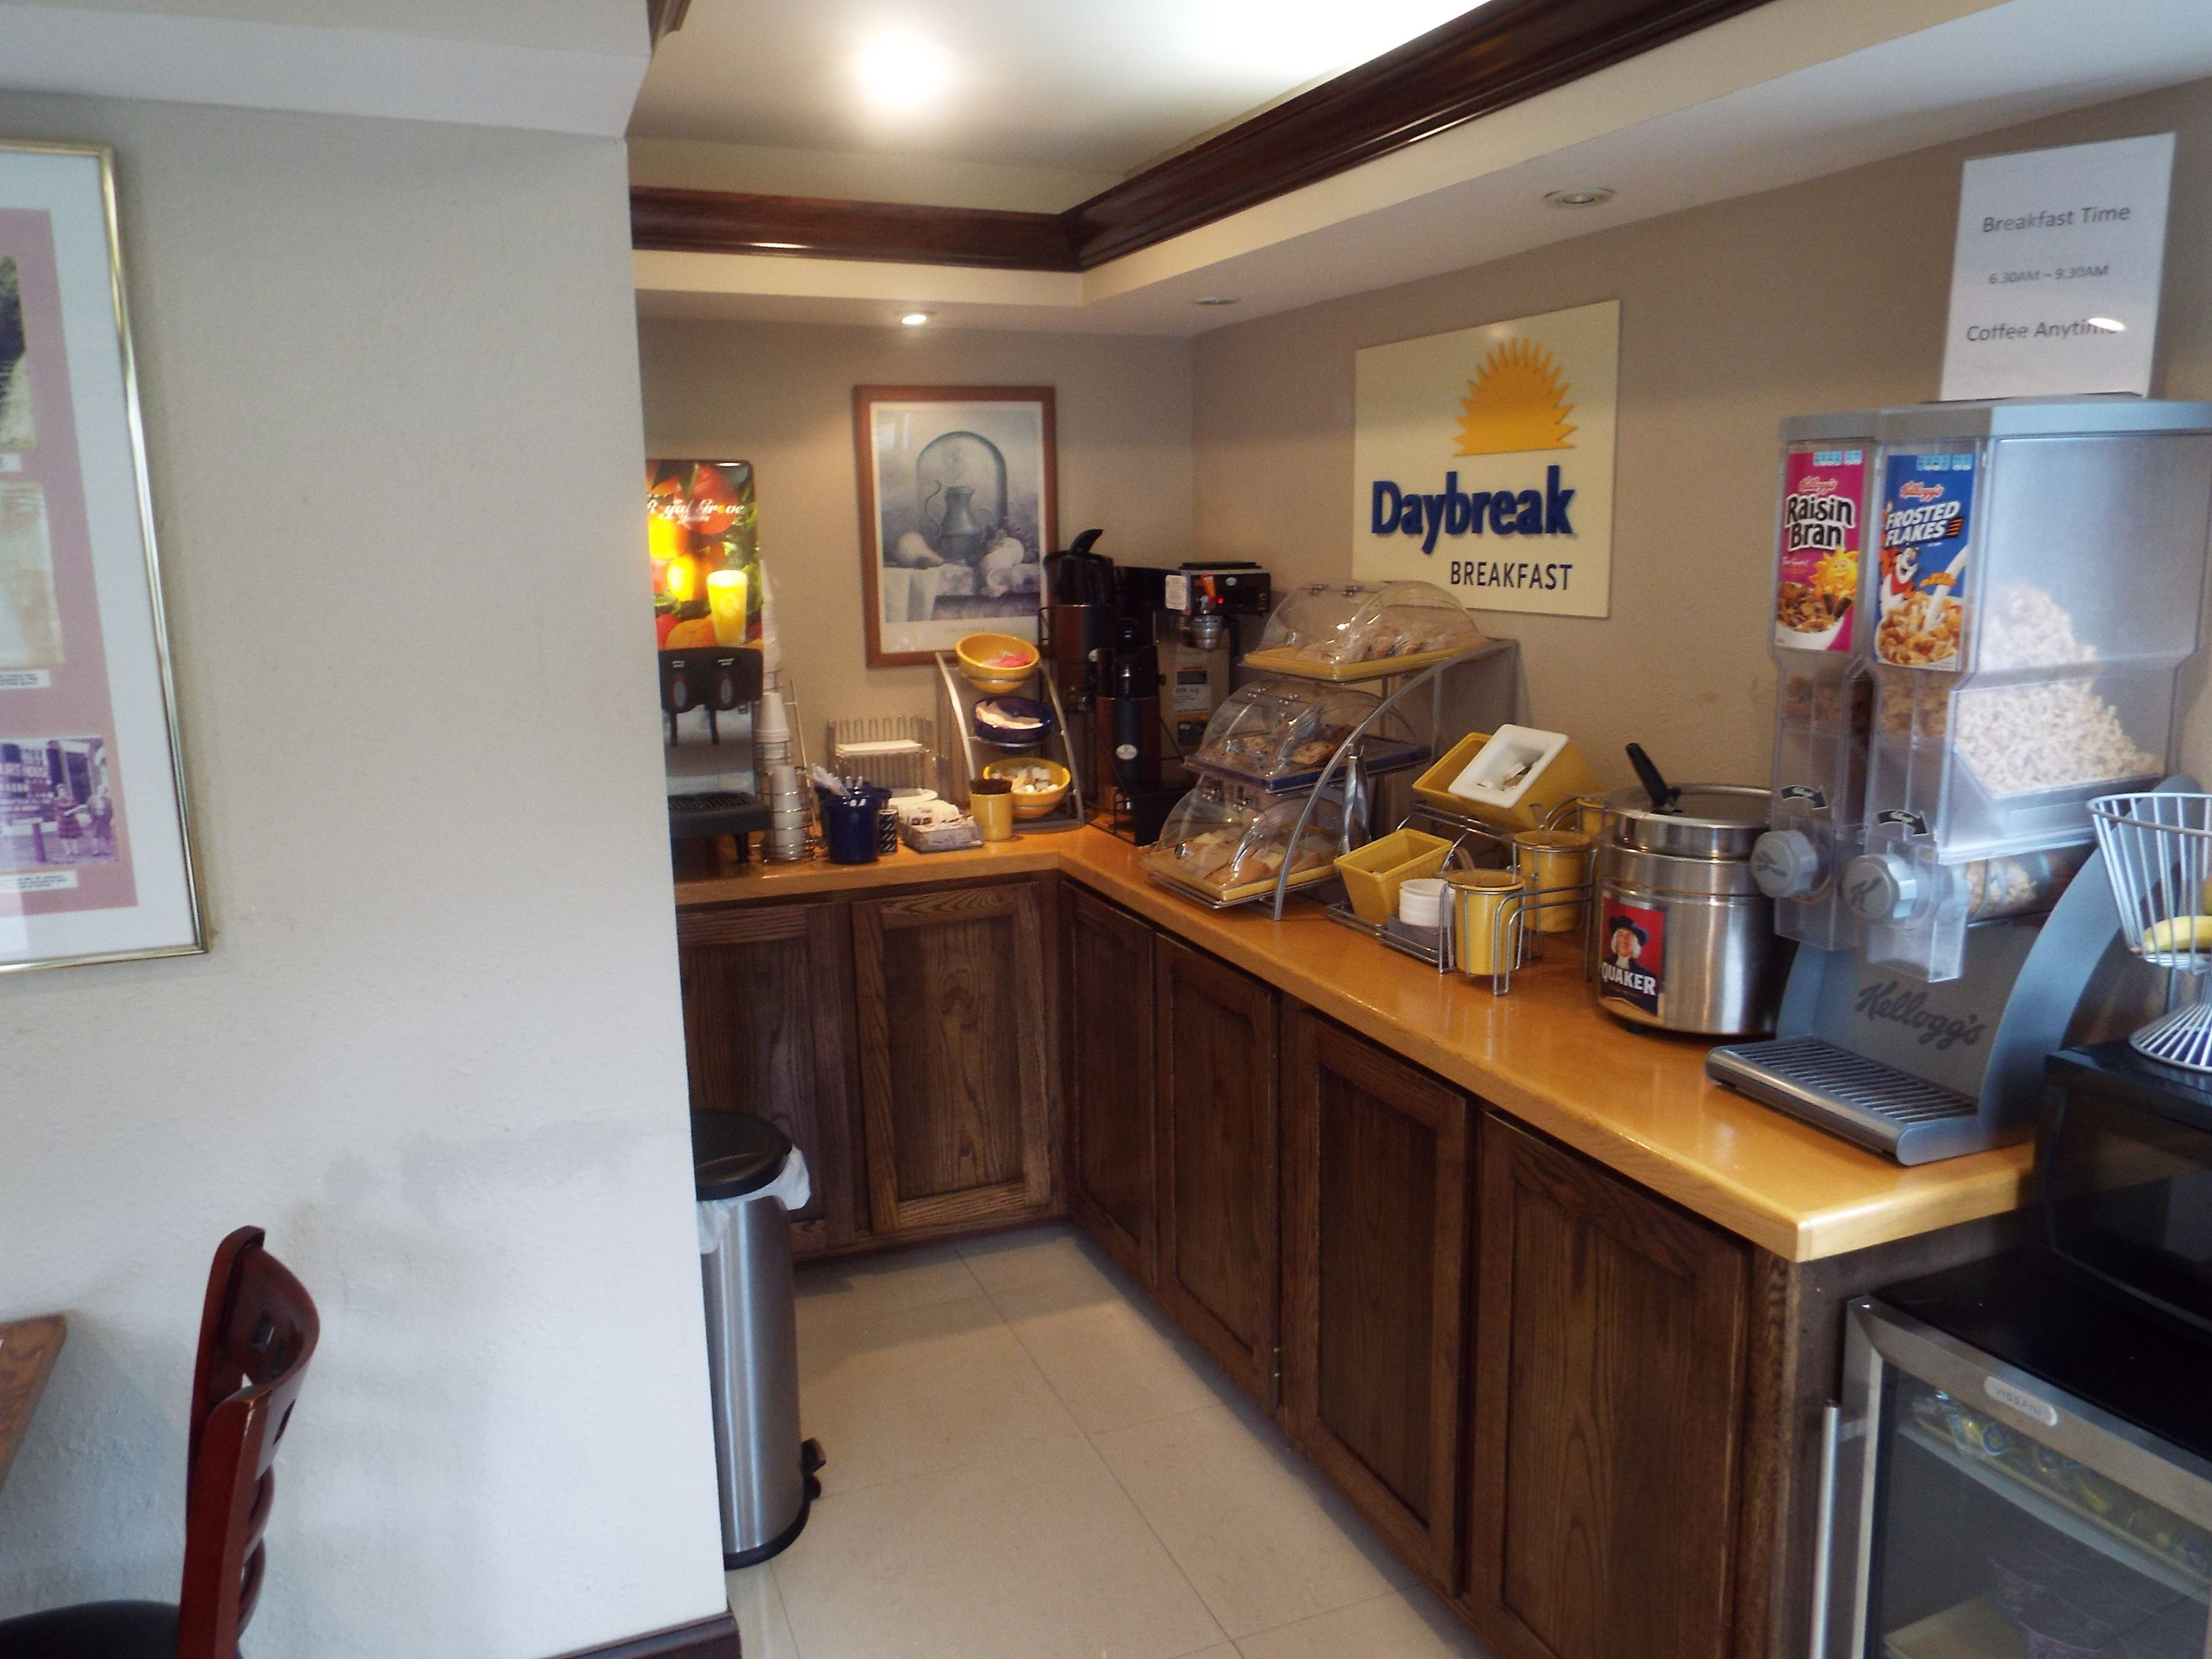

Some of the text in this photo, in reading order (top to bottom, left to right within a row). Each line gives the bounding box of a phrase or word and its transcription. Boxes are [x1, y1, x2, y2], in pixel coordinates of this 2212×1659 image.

[1982, 206, 2131, 233] Breakfast Time
[1989, 270, 2040, 284] 6.30AM
[2055, 265, 2109, 279] 9.30AM
[1967, 318, 2119, 341] Coffee Anytim
[1372, 464, 1576, 554] Daybreak
[1786, 494, 1855, 528] Raisin
[1886, 501, 1961, 530] FROSTED
[1790, 522, 1844, 549] Bran
[1885, 520, 1948, 547] FLAKES
[1450, 560, 1573, 590] BREAKFAST
[1601, 961, 1657, 996] QUAKER
[1856, 980, 1987, 1051] Kellogg's
